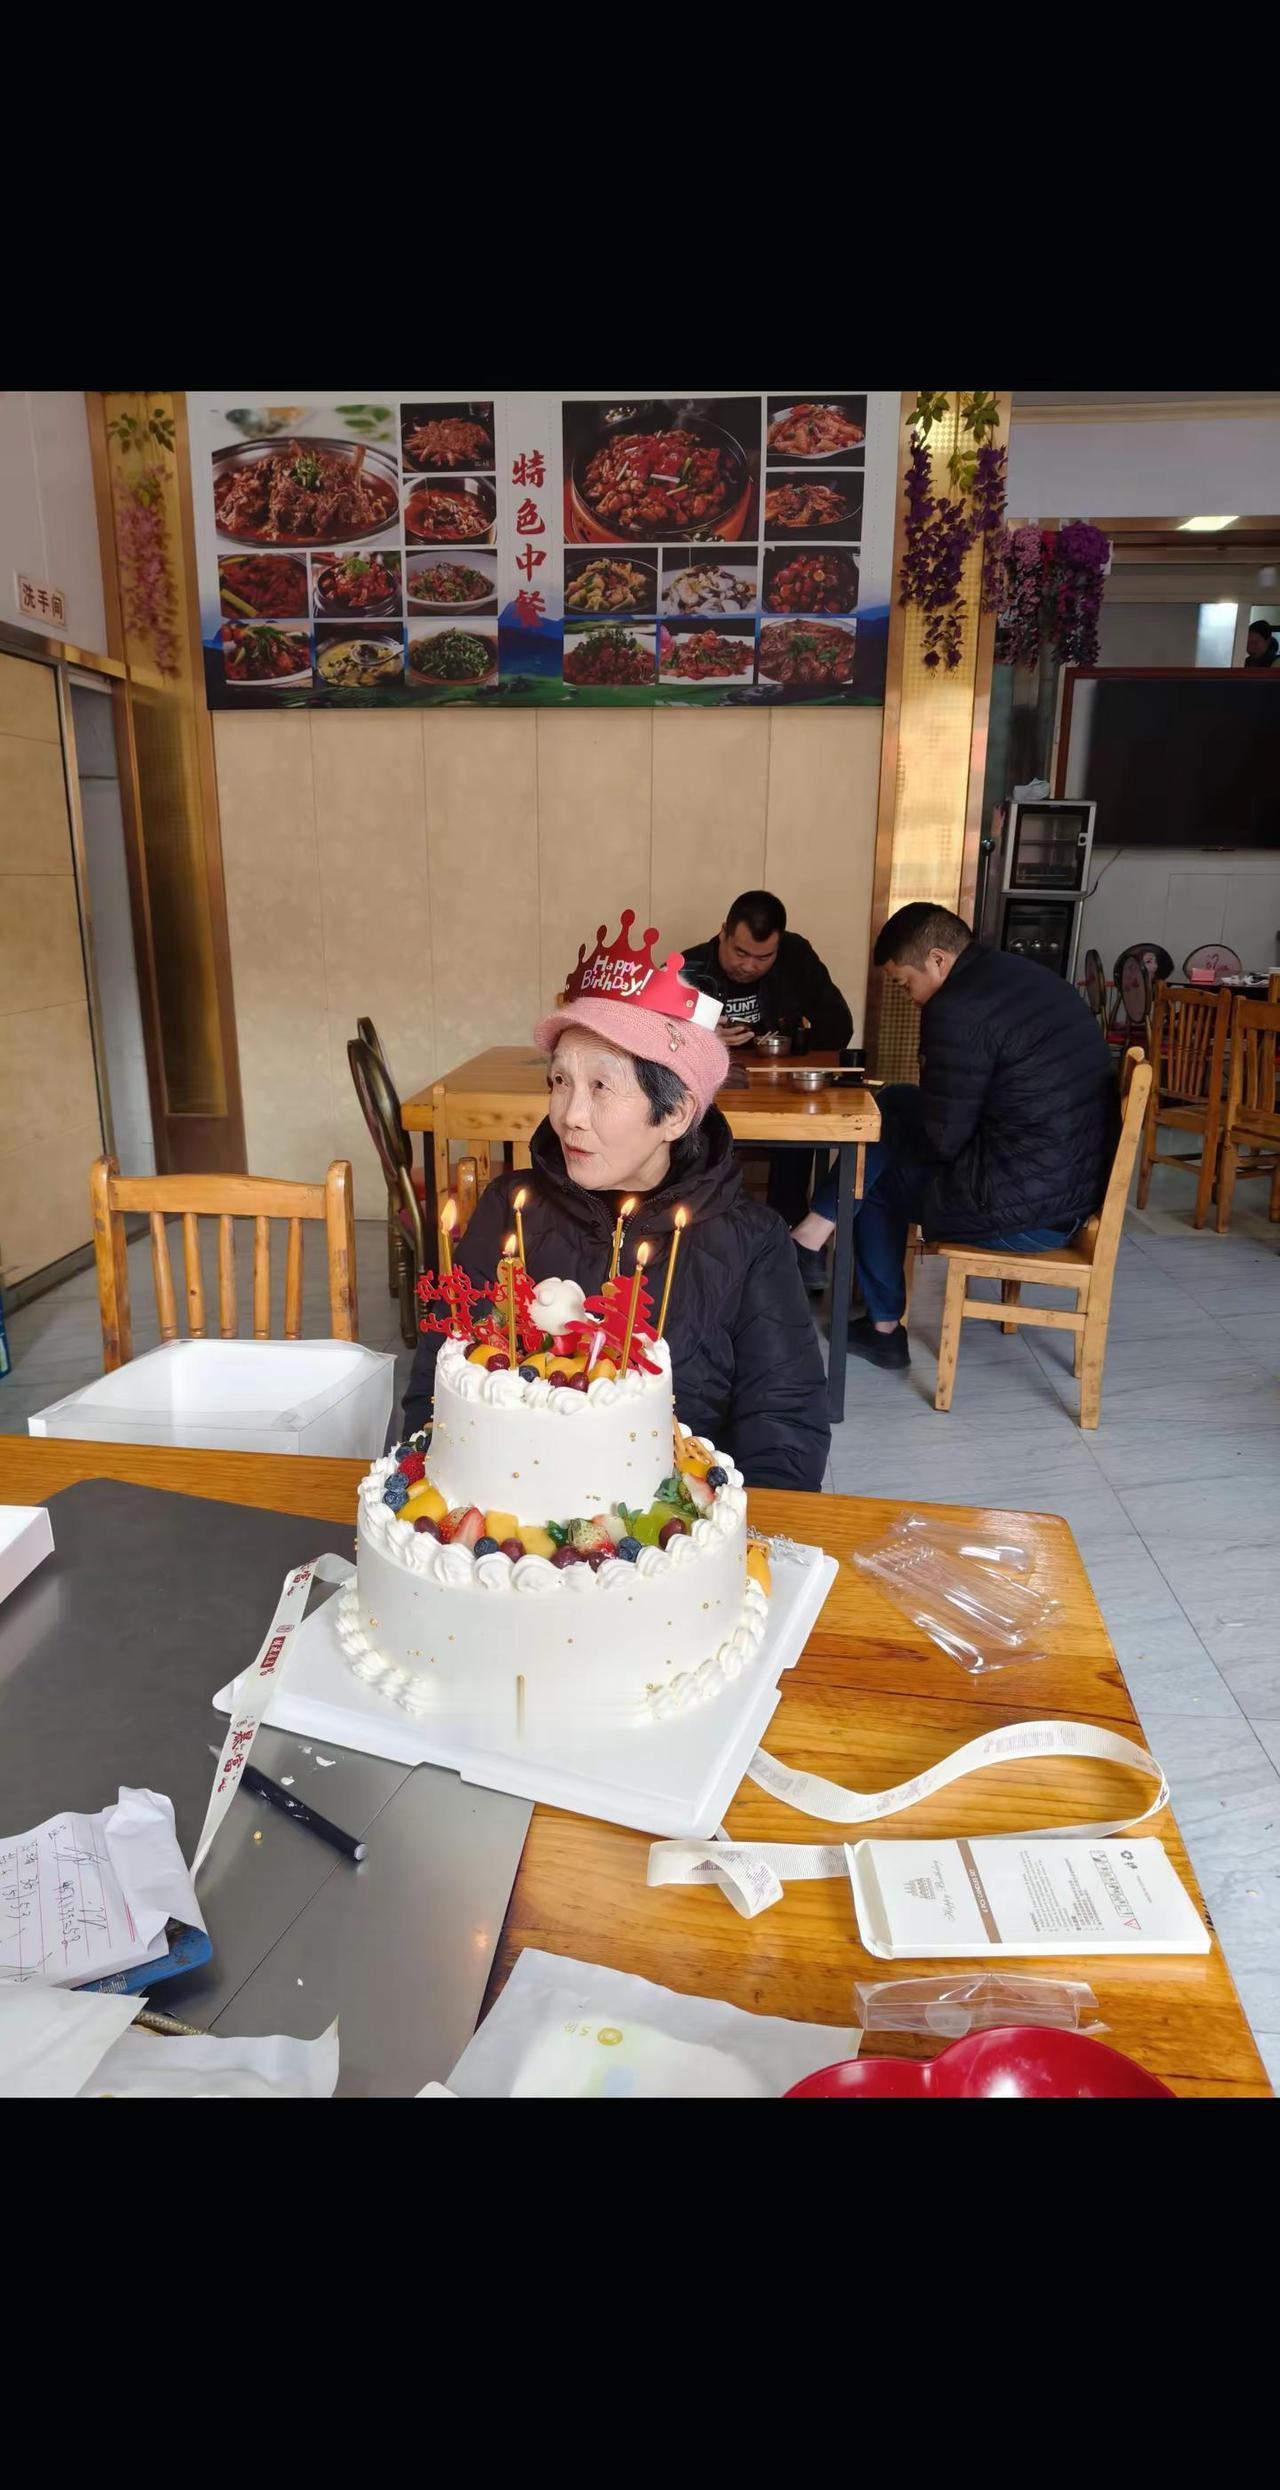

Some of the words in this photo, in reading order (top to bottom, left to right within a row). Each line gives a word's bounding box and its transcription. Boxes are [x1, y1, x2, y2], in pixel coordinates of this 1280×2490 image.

[512, 450, 547, 628] 特色中餐
[22, 583, 63, 620] 洗手间
[592, 955, 643, 977] Happy
